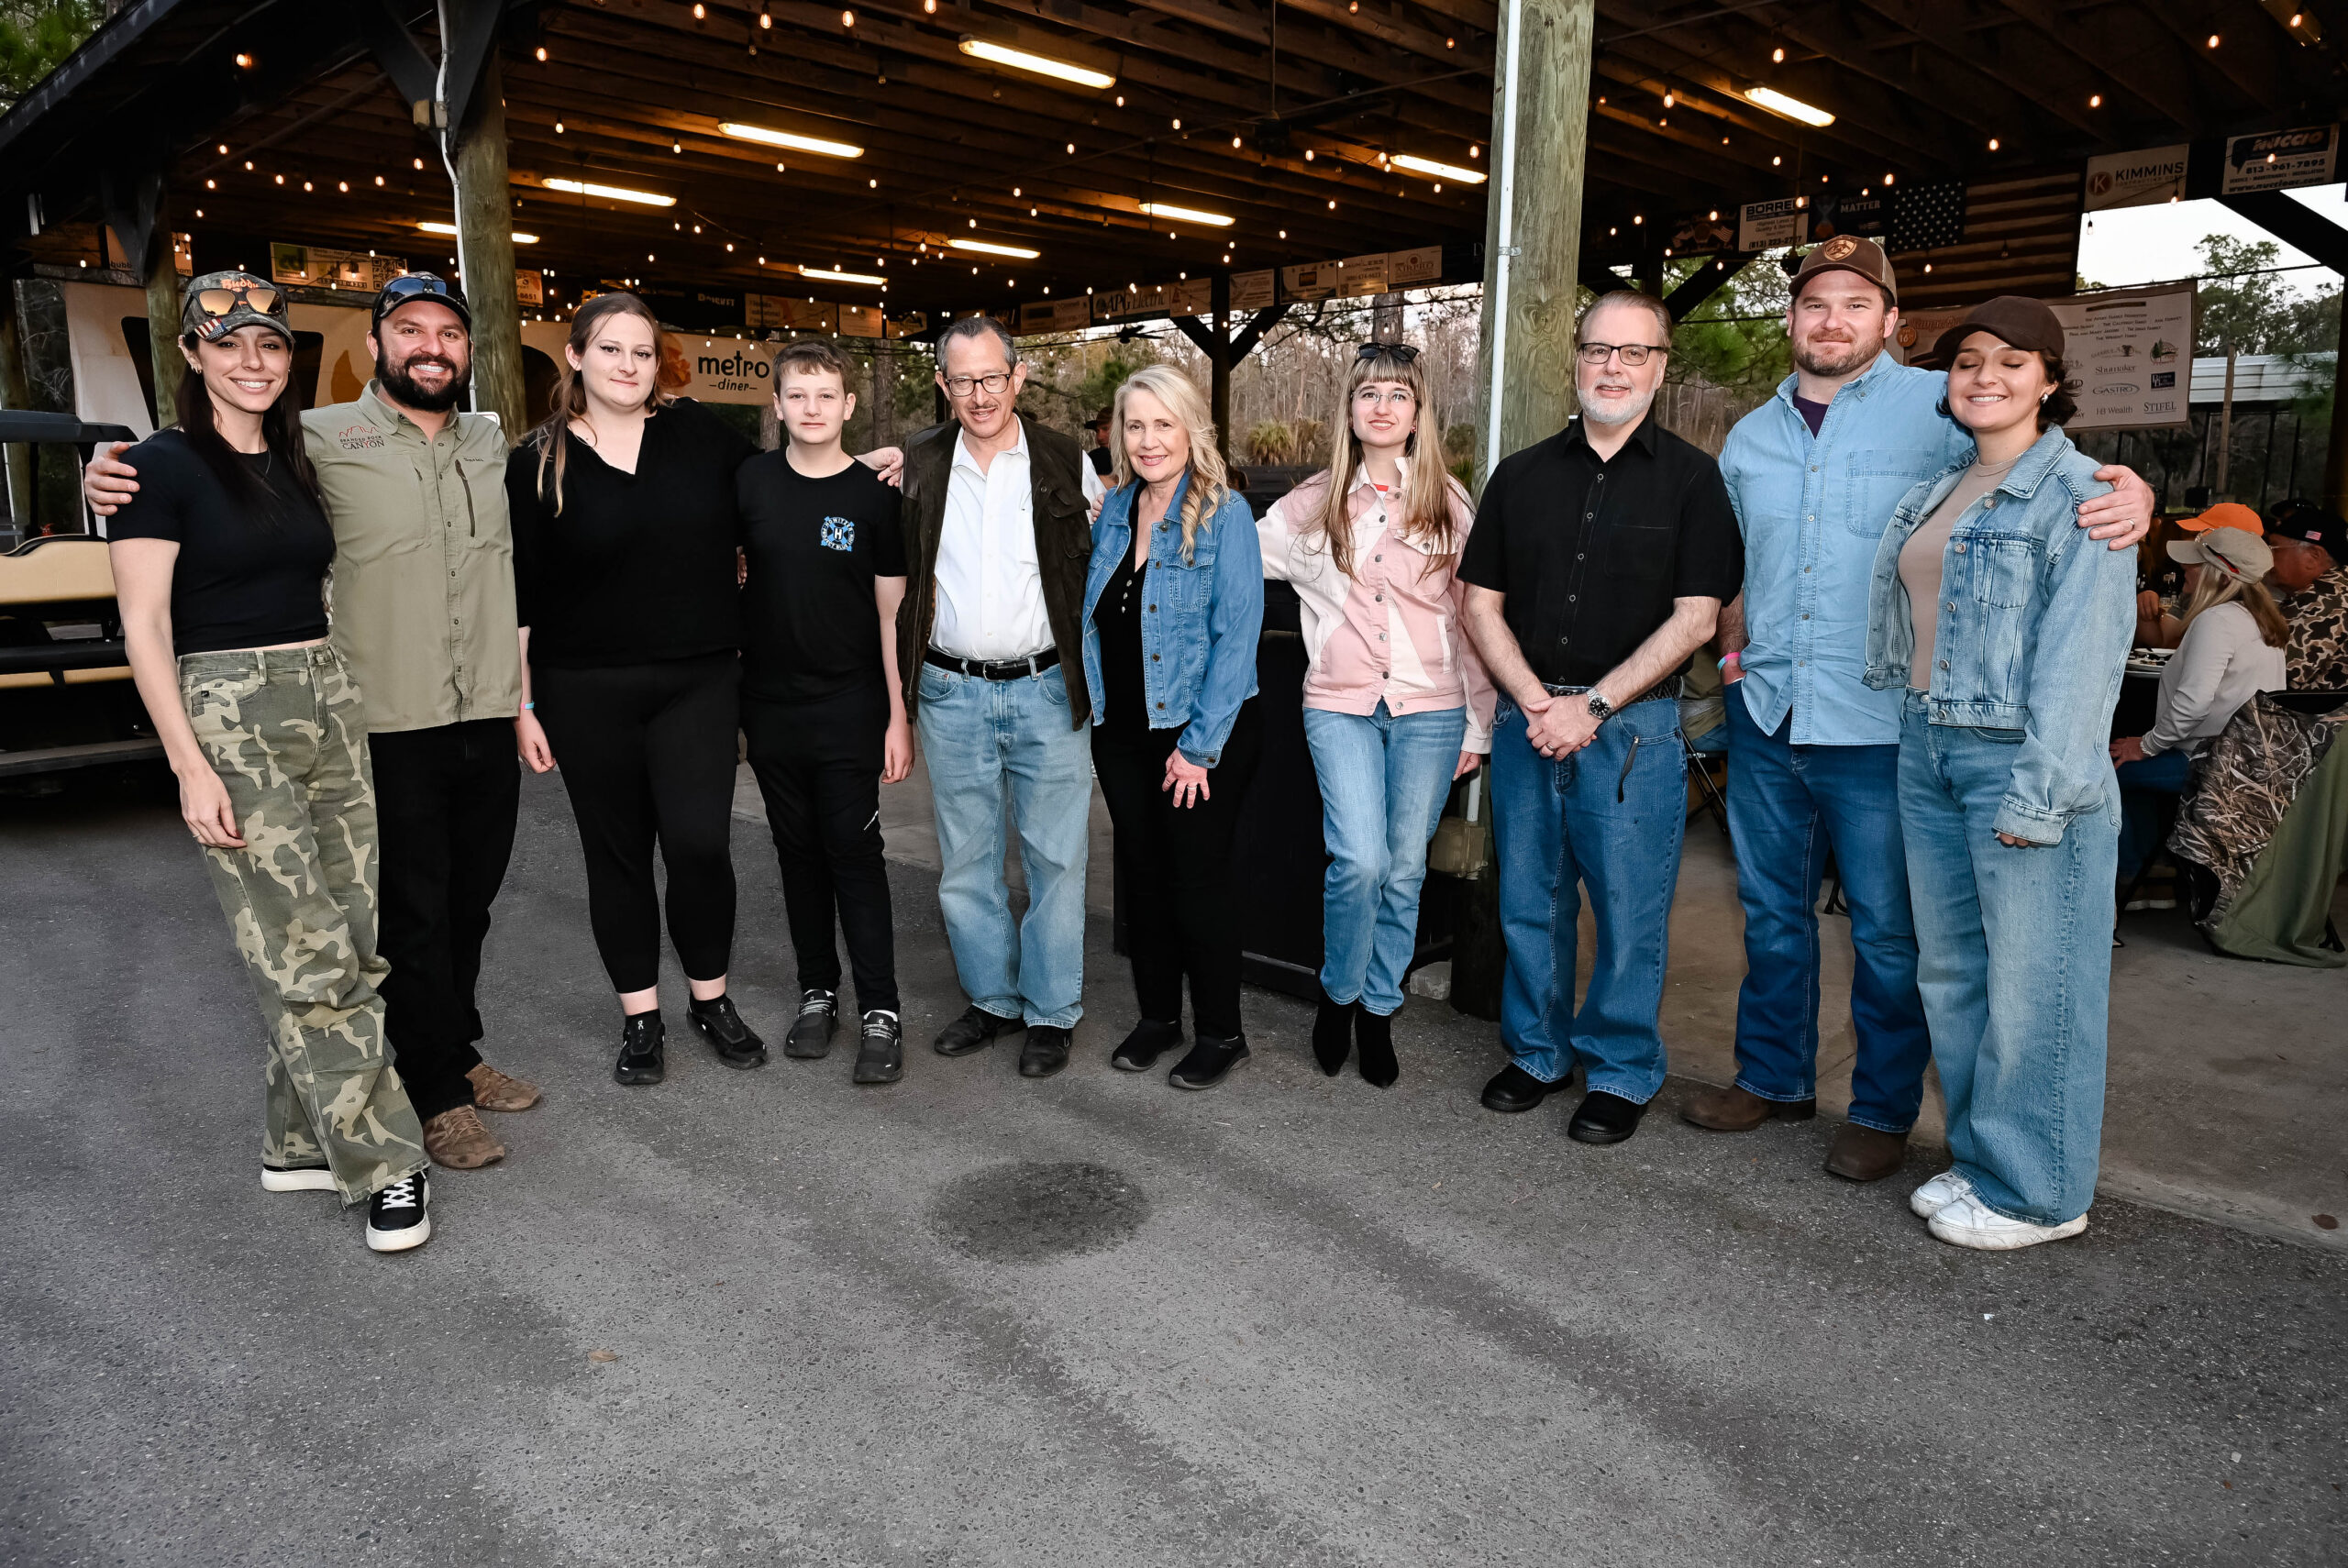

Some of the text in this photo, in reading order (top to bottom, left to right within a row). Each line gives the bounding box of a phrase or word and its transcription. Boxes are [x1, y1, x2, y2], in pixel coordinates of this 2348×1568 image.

[2115, 161, 2184, 182] KIMMINS
[2094, 175, 2107, 193] K
[1746, 197, 1808, 215] BORRE
[1840, 200, 1881, 213] MATTER
[1768, 235, 1802, 246] 223-277
[1107, 293, 1130, 313] APG
[698, 350, 770, 378] metro
[2095, 364, 2136, 374] Shumaker
[717, 378, 750, 392] diner
[2108, 405, 2133, 414] Wealth
[2143, 402, 2177, 412] STIFEL
[342, 440, 384, 449] CANYON
[834, 527, 843, 541] H
